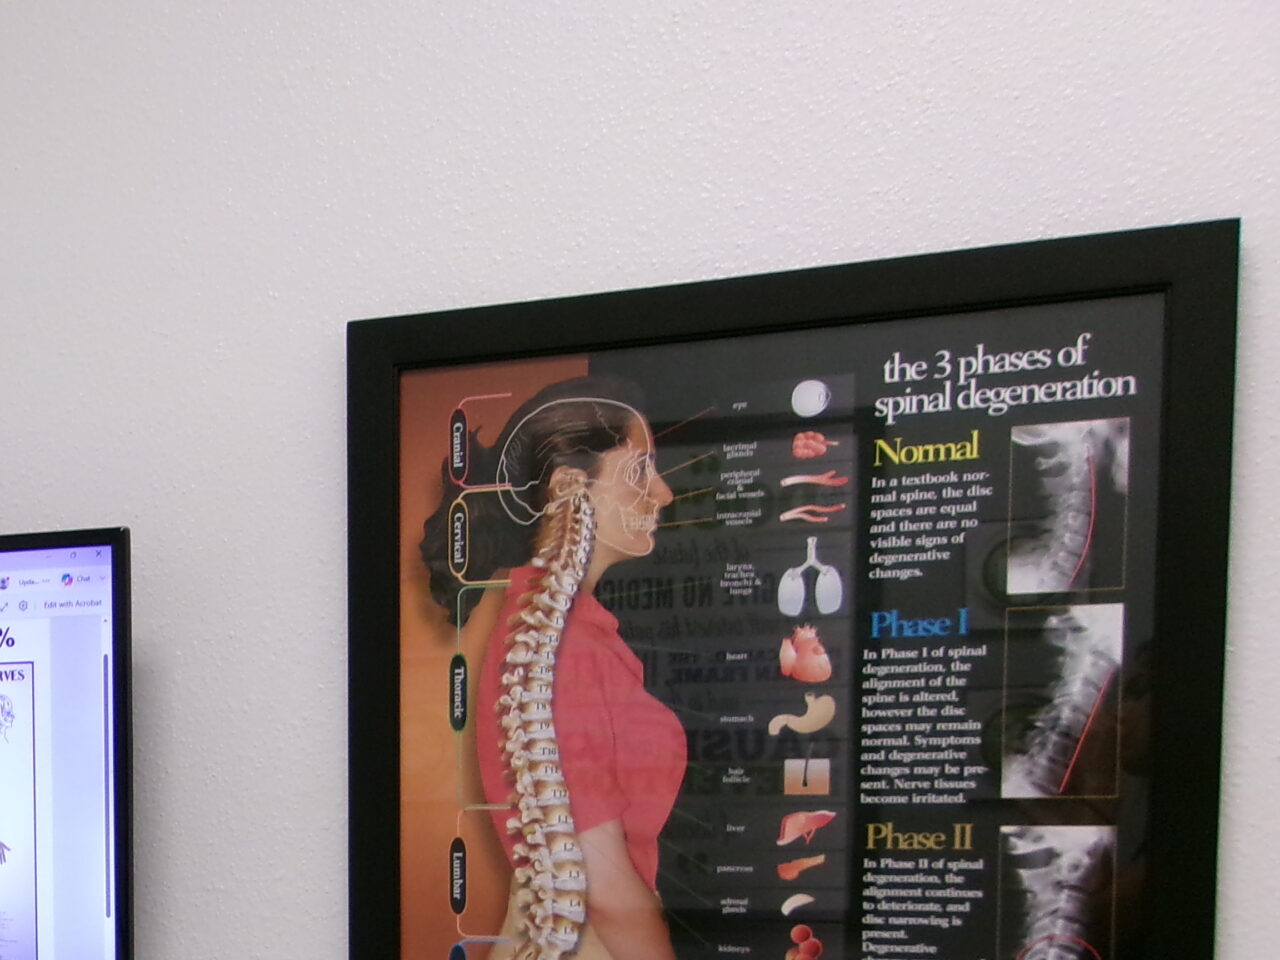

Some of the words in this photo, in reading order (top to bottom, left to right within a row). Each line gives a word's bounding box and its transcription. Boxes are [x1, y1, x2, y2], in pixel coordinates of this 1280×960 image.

[884, 351, 928, 383] the
[933, 349, 951, 379] 3
[957, 343, 1051, 385] phases
[1057, 333, 1091, 368] of
[874, 382, 952, 425] spinal
[957, 369, 1138, 416] degeneration
[453, 422, 463, 468] Cranial
[874, 430, 980, 466] Normal
[872, 477, 886, 488] In
[890, 479, 898, 487] a
[902, 471, 958, 486] textbook
[963, 472, 990, 481] nor-
[872, 491, 896, 503] mal
[900, 489, 937, 503] spine,
[942, 487, 963, 498] the
[967, 485, 993, 497] disc
[871, 507, 912, 520] spaces
[916, 506, 936, 515] are
[940, 501, 977, 516] equal
[870, 521, 894, 533] and
[899, 520, 933, 532] there
[936, 520, 957, 529] are
[961, 518, 978, 527] no
[454, 513, 464, 563] Cervical
[870, 536, 912, 548] visible
[915, 535, 947, 548] signs
[951, 532, 966, 544] of
[869, 549, 950, 565] degenerative
[869, 567, 923, 580] changes.
[44, 601, 56, 609] Edit
[871, 609, 953, 638] Phase
[958, 608, 968, 635] I
[726, 652, 747, 660] heart
[863, 650, 877, 660] In
[881, 648, 919, 659] Phase
[922, 648, 928, 658] I
[931, 646, 945, 657] of
[948, 645, 987, 659] spinal
[951, 661, 972, 672] the
[862, 677, 925, 690] alignment
[929, 676, 944, 687] of
[946, 676, 967, 686] the
[454, 666, 464, 719] Thoracic
[862, 693, 895, 705] spine
[899, 692, 909, 702] is
[862, 707, 913, 717] however
[917, 706, 937, 716] the
[941, 705, 965, 716] disc
[861, 723, 901, 734] spaces
[906, 722, 933, 733] may
[936, 720, 982, 730] remain
[861, 736, 910, 746] normal.
[914, 735, 982, 747] Symptoms
[861, 751, 885, 761] and
[888, 750, 967, 763] degenerative
[860, 765, 910, 777] changes
[914, 766, 941, 777] may
[945, 764, 960, 774] be
[964, 766, 989, 776] pre-
[860, 780, 889, 789] sent.
[894, 780, 930, 789] Nerve
[934, 779, 976, 789] tissues
[860, 794, 908, 803] become
[912, 794, 966, 803] irritated.
[866, 822, 946, 850] Phase
[952, 823, 974, 850] II
[864, 858, 876, 868] In
[880, 859, 915, 869] Phase
[932, 859, 945, 869] of
[947, 859, 984, 871] spinal
[453, 852, 463, 899] Lumbar
[945, 873, 965, 883] the
[862, 887, 922, 898] alignment
[925, 889, 983, 898] continues
[862, 902, 874, 910] to
[946, 902, 969, 912] and
[862, 914, 885, 924] disc
[888, 916, 949, 928] narrowing
[952, 916, 962, 926] is
[862, 942, 937, 955] Degenerative
